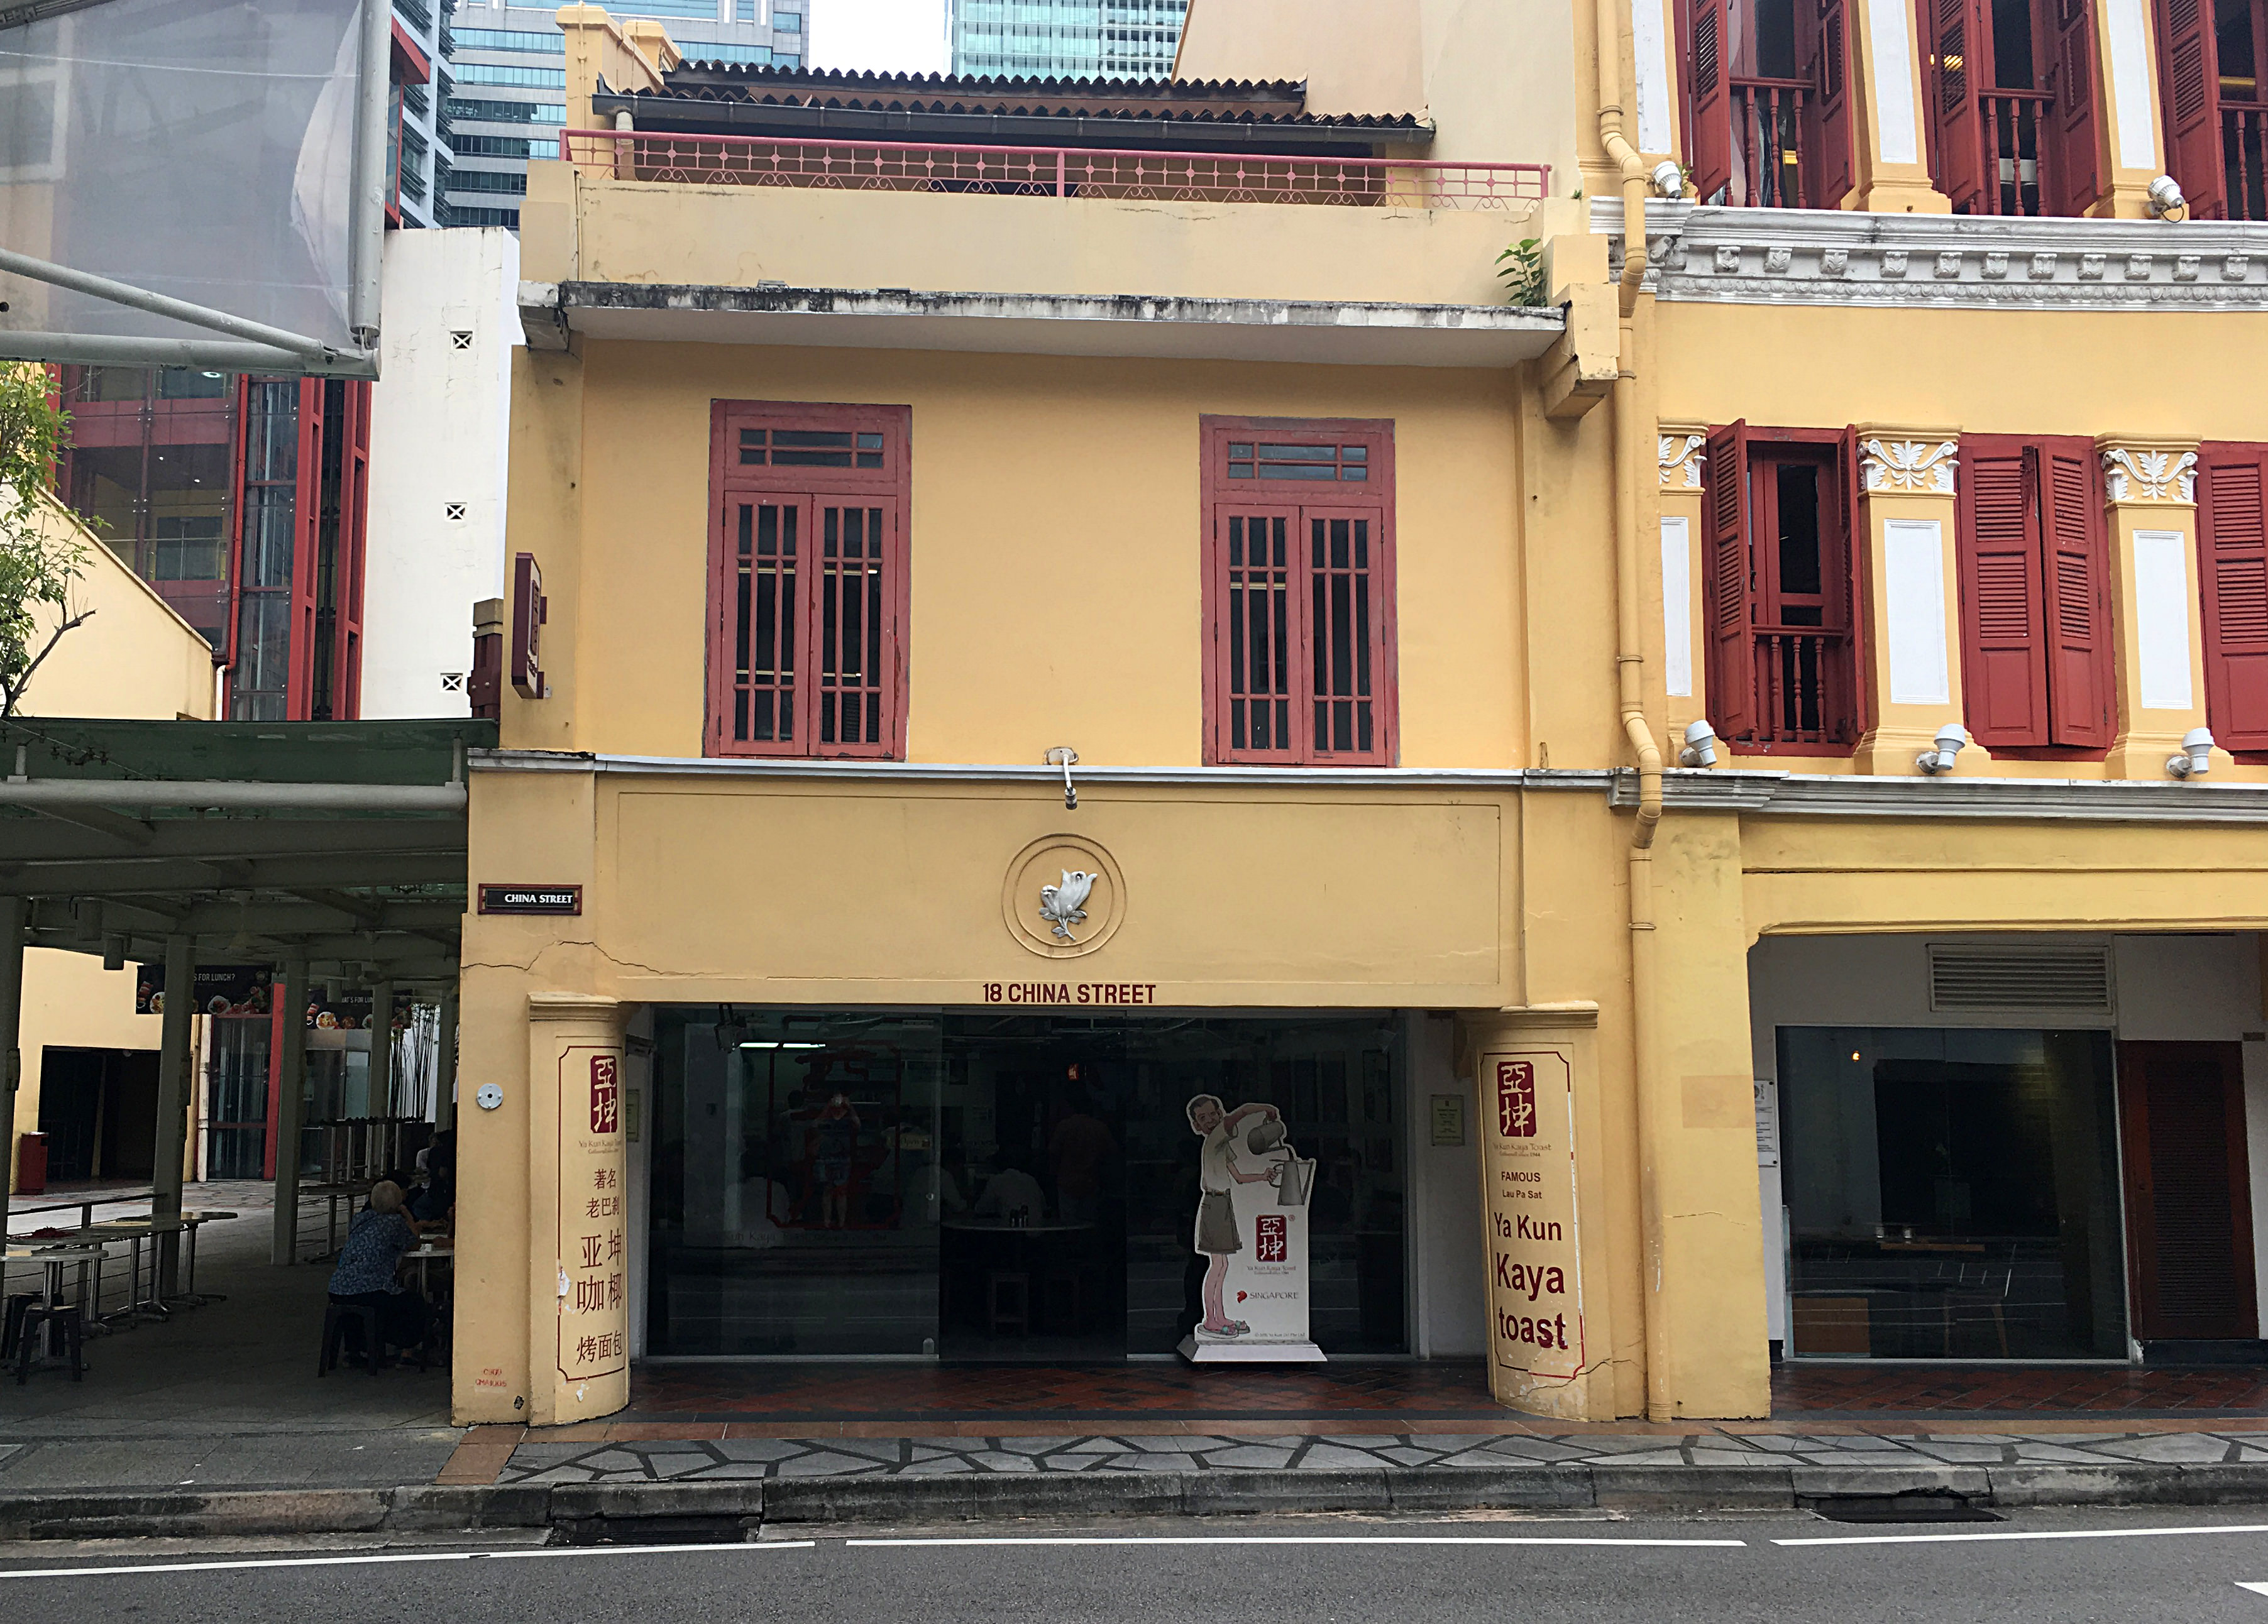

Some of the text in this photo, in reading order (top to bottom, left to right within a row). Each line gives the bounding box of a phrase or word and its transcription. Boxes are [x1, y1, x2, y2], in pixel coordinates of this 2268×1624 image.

[505, 894, 573, 904] CHINA STREET
[983, 984, 1156, 1004] 18 CHINA STREET
[593, 1057, 617, 1133] 亞坤
[1500, 1063, 1533, 1138] 亞坤
[1529, 1143, 1552, 1151] Toast
[594, 1168, 616, 1190] 著名
[1501, 1171, 1541, 1182] FAMOUS
[586, 1195, 620, 1218] 老巴刹
[1502, 1190, 1542, 1199] Lau Pa Sat
[1494, 1212, 1562, 1241] Ya Kun
[580, 1227, 621, 1268] 亚坤
[1497, 1252, 1565, 1302] Kaya
[576, 1272, 622, 1315] 咖椰
[1250, 1292, 1299, 1300] SINGAPORE
[1499, 1306, 1568, 1350] toast
[576, 1330, 622, 1366] 烤面包
